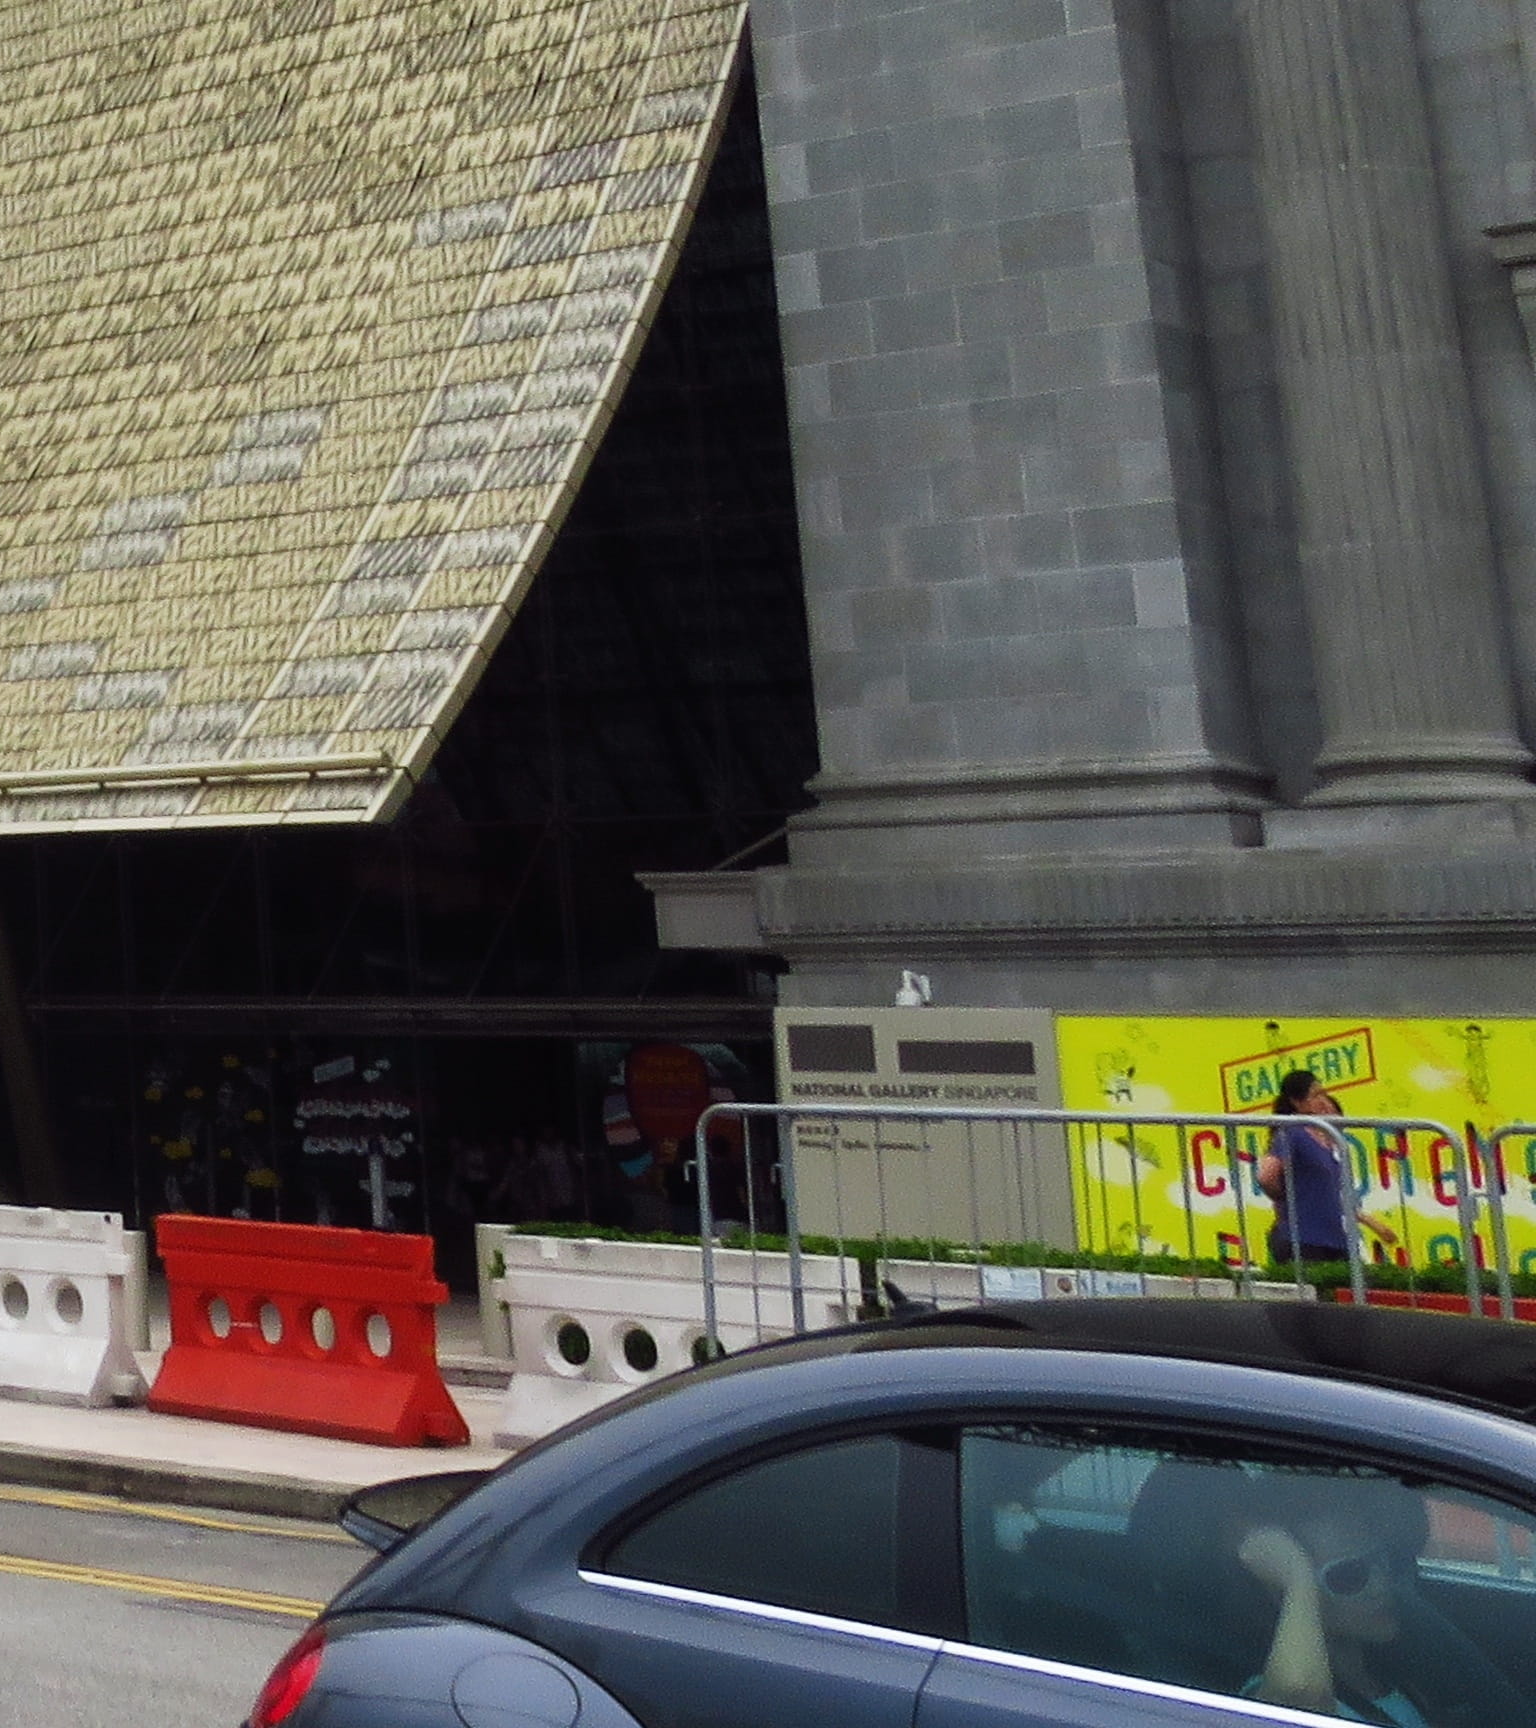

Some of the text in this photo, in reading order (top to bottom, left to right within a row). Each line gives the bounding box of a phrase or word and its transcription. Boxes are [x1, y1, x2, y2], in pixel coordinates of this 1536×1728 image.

[792, 1082, 1038, 1101] NATIONAL GALLERY SINGAPORE
